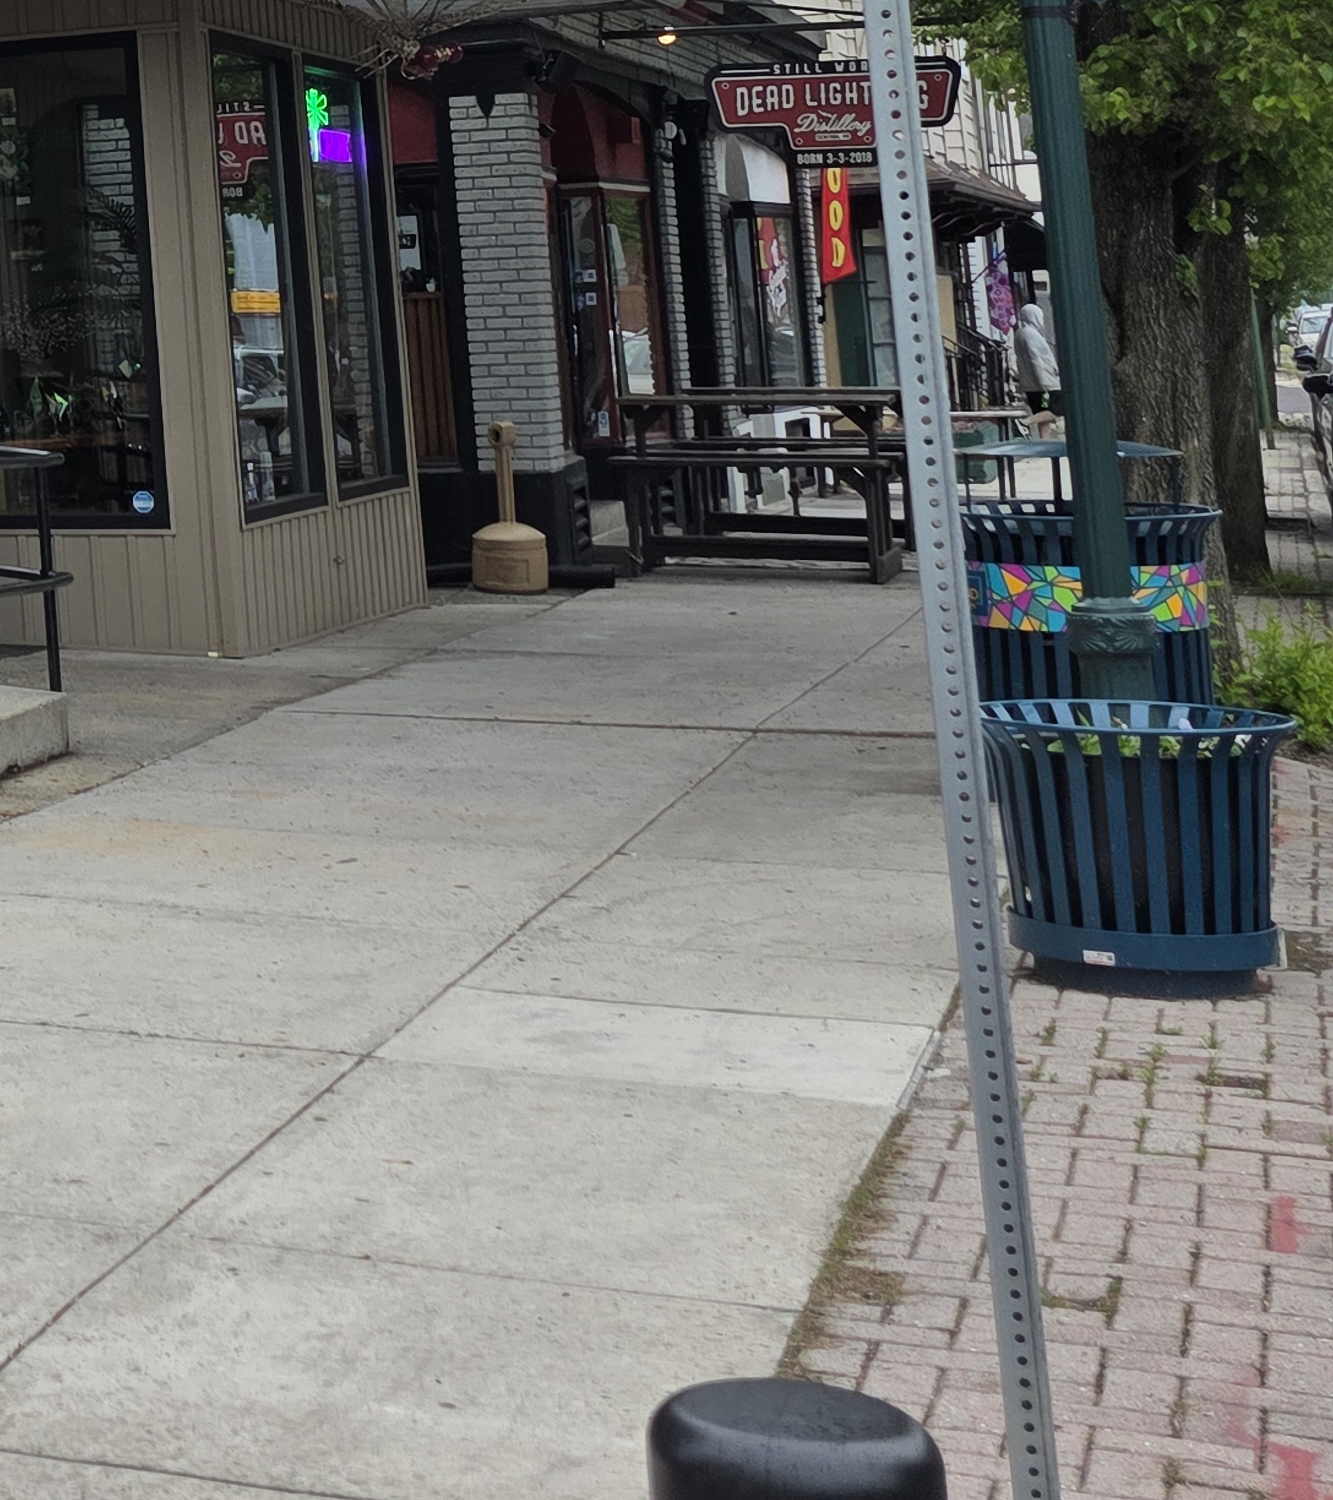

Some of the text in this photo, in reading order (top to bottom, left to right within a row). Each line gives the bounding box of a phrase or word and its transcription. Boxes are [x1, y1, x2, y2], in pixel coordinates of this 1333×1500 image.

[773, 62, 869, 75] STILL WOR
[736, 84, 795, 117] DEAD
[797, 153, 823, 165] BORN
[827, 168, 846, 268] OOD
